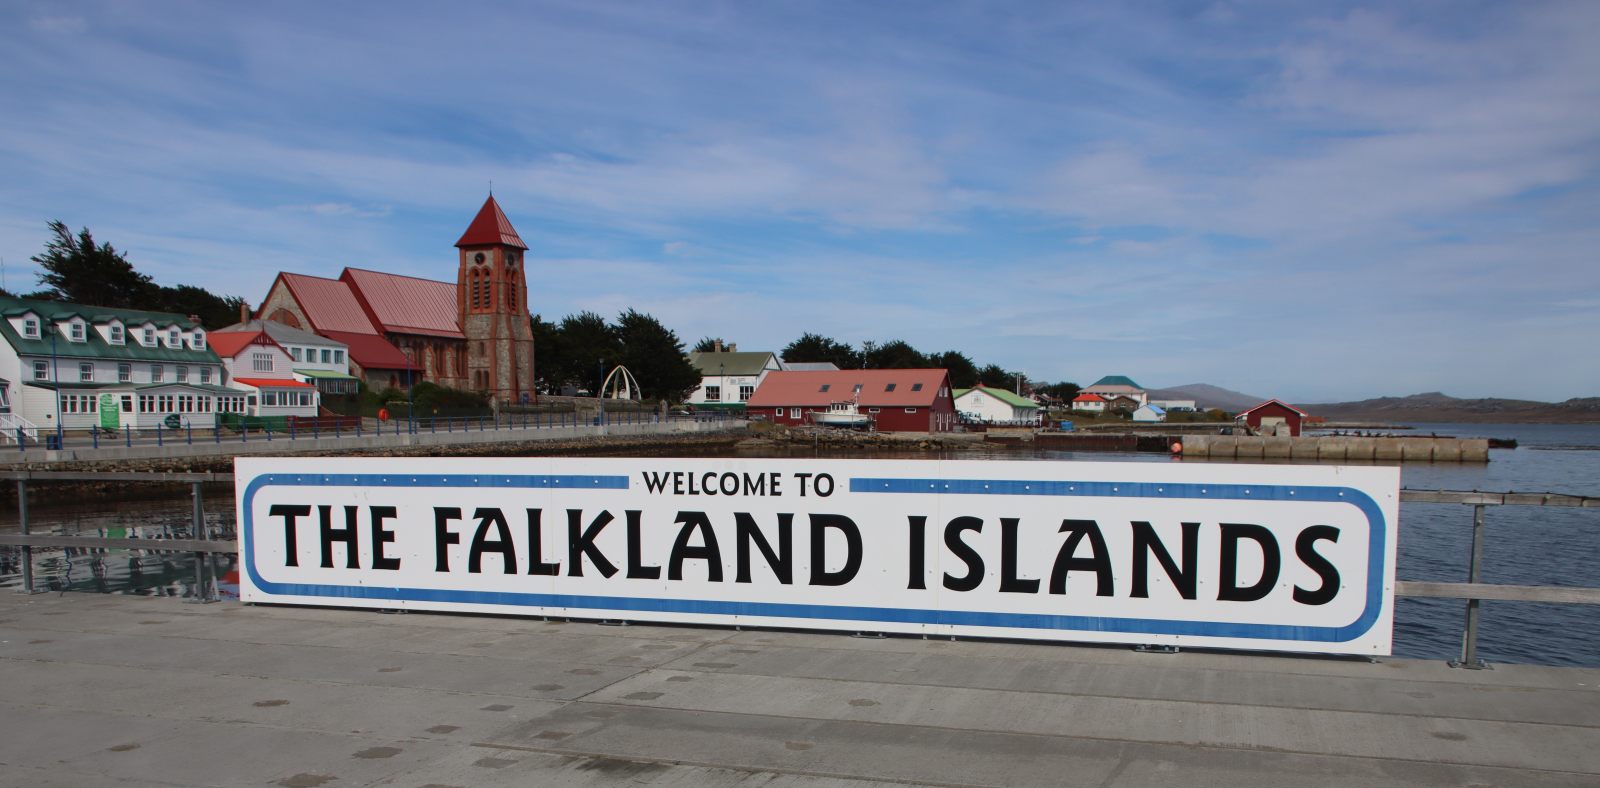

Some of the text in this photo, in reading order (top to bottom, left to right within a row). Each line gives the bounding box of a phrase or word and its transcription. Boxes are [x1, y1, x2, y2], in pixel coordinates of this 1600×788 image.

[642, 471, 835, 497] WELCOME TO
[269, 504, 1341, 606] THE FALKLAND ISLANDS
